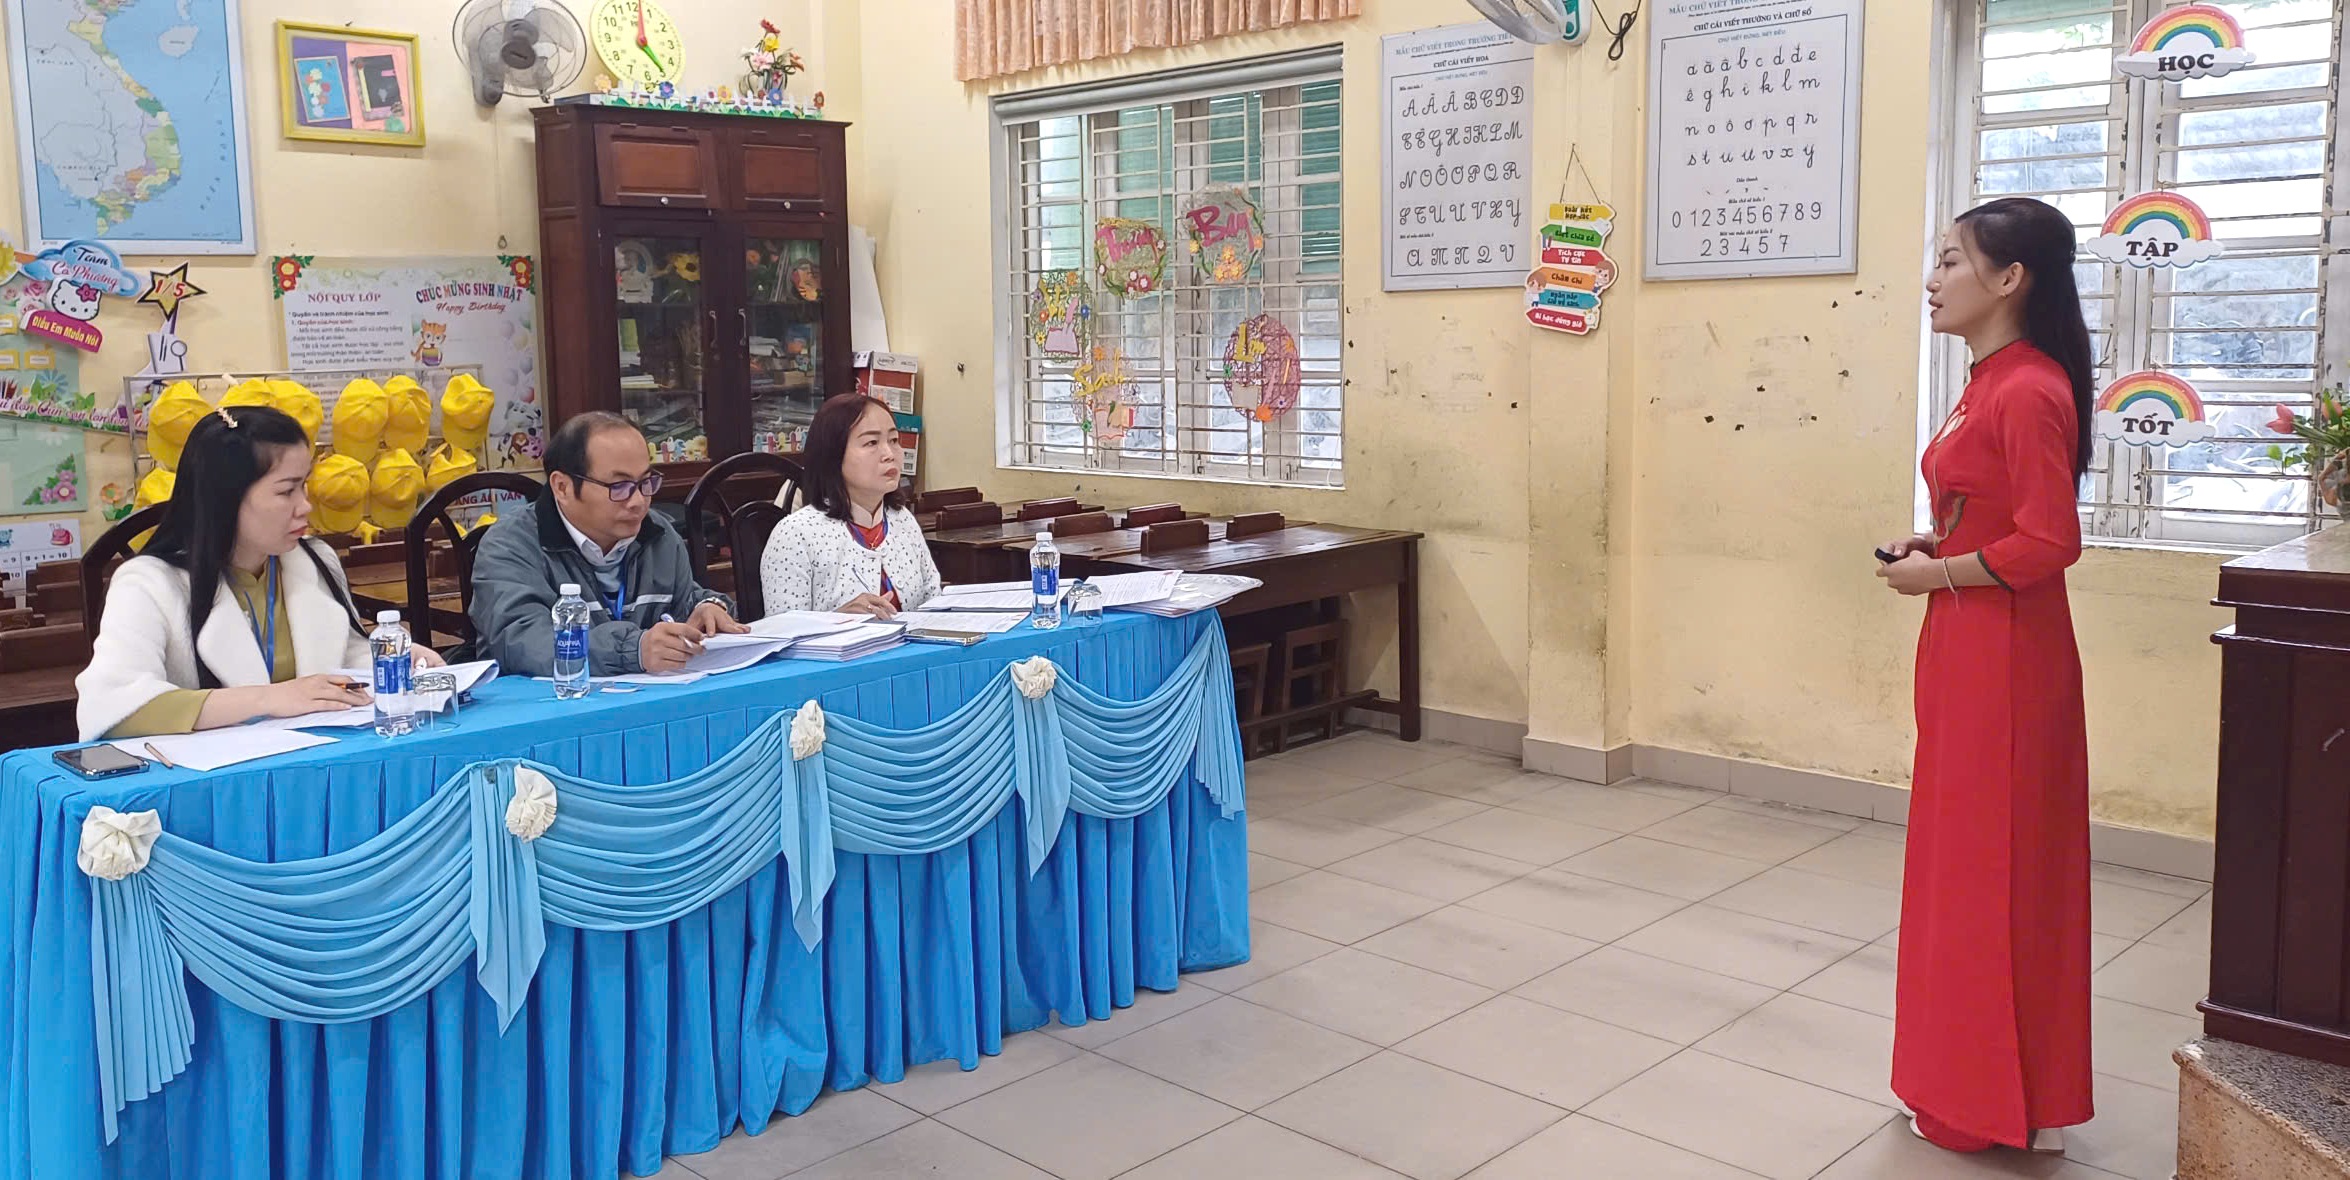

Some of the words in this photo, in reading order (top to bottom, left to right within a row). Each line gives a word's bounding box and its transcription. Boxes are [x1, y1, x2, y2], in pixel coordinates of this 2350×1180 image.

[612, 4, 623, 14] 11
[626, 1, 639, 13] 12
[646, 8, 652, 18] 1
[603, 16, 616, 27] 10
[659, 22, 667, 32] 2
[604, 32, 611, 42] 9
[667, 39, 674, 49] 3
[612, 50, 620, 60] 8
[668, 56, 674, 66] 4
[2157, 53, 2216, 76] HỌC
[626, 64, 633, 74] 7
[644, 70, 651, 80] 6
[2125, 236, 2180, 262] TẬP
[73, 246, 109, 266] Team
[154, 278, 186, 298] 1/5
[415, 285, 442, 303] CHÚC
[443, 279, 471, 297] MỪNG
[474, 282, 495, 297] SINH
[307, 291, 328, 303] NỘI
[332, 293, 355, 304] QUY
[359, 291, 381, 302] LỚP
[436, 301, 464, 315] Happy
[468, 301, 506, 314] Birthday
[50, 321, 64, 335] Em
[2122, 411, 2175, 436] TỐT
